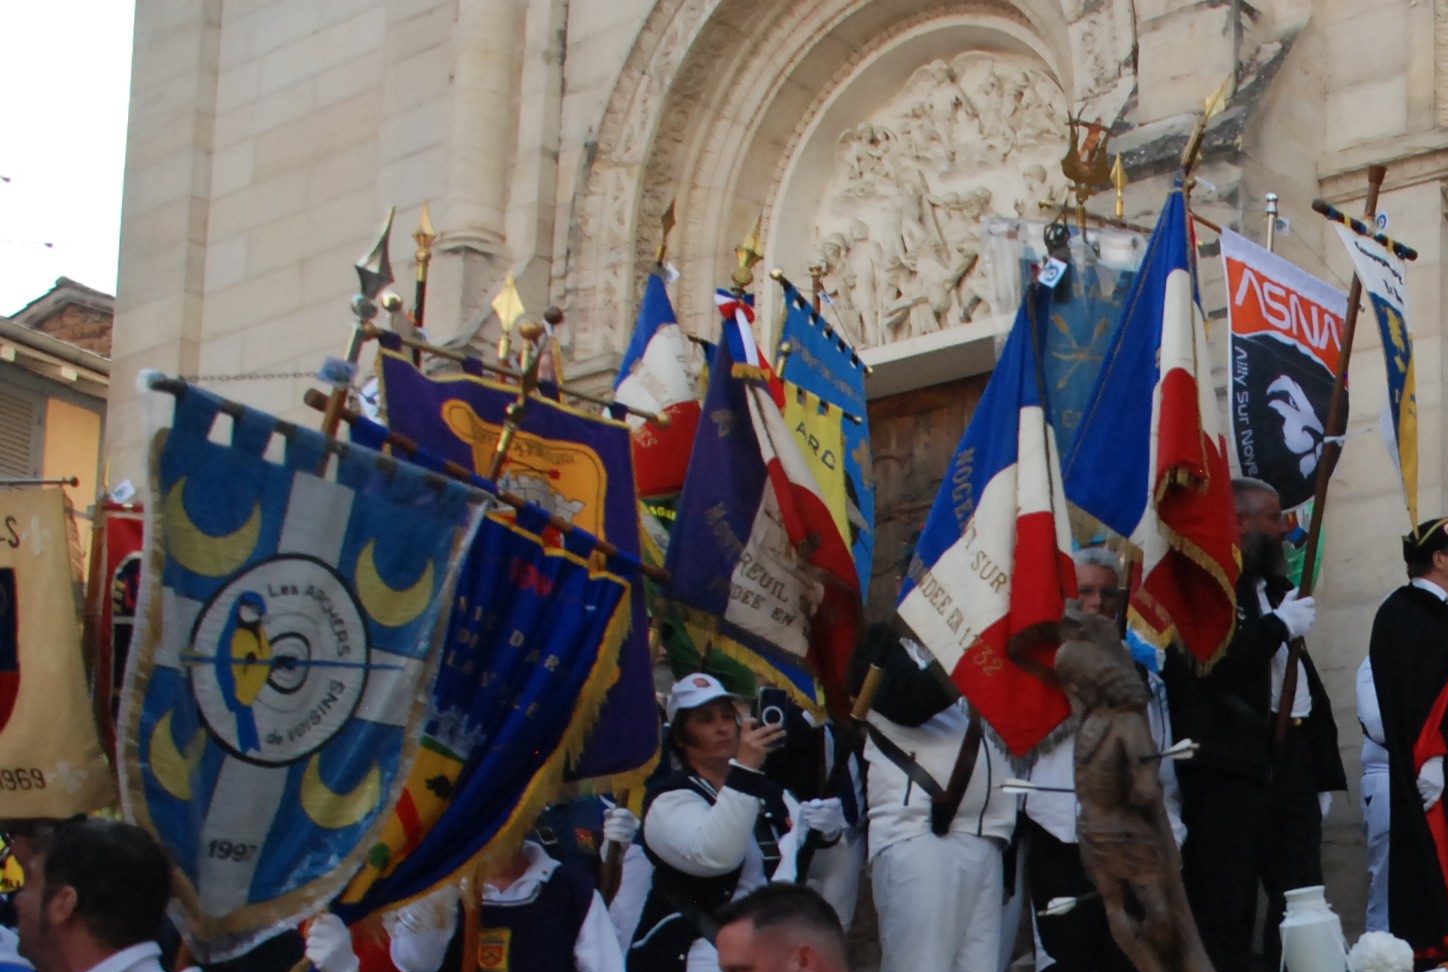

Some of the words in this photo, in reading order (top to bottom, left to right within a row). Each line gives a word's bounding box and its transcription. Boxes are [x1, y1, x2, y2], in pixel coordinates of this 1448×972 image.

[1237, 391, 1250, 425] Sur
[796, 421, 836, 471] ARC
[971, 550, 1008, 594] SUR
[267, 583, 309, 598] Les
[305, 584, 352, 657] ARCHERS
[772, 607, 796, 626] EN
[946, 603, 964, 635] EN
[958, 627, 1003, 677] 1732
[266, 729, 284, 746] de
[208, 839, 258, 863] 1997
